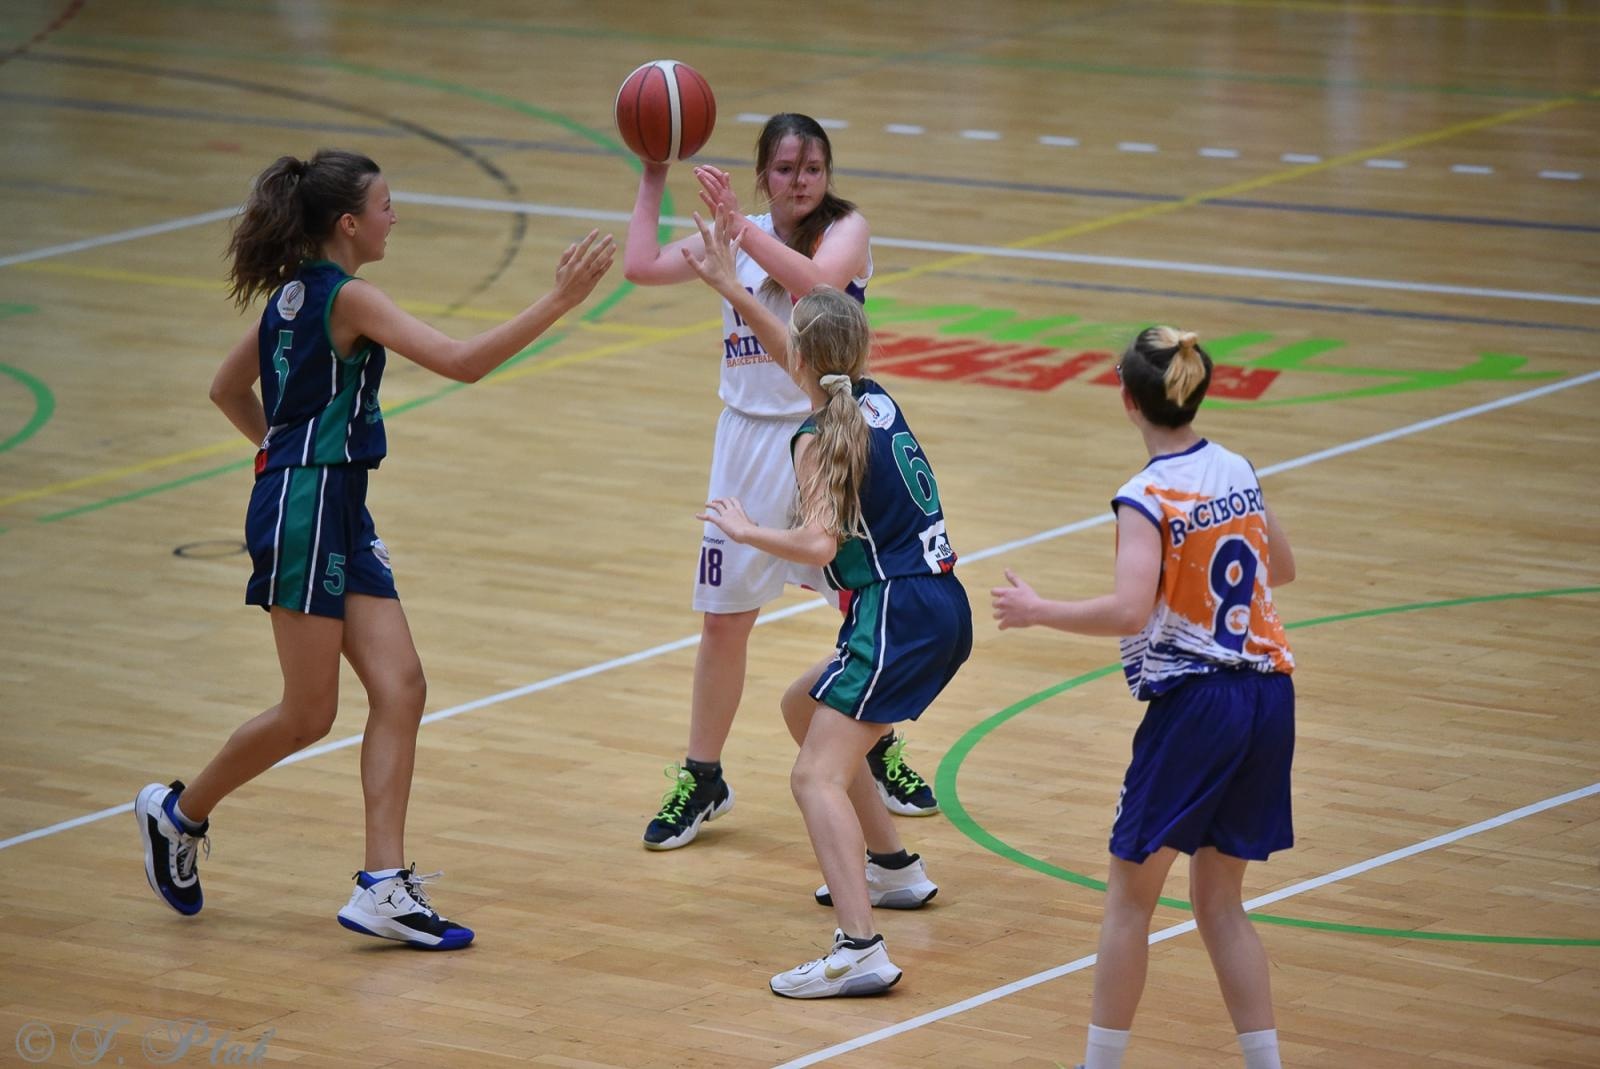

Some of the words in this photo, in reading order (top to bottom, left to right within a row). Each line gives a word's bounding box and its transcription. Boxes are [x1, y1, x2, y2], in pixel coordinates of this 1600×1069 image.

[272, 329, 294, 417] 5
[891, 431, 941, 516] 6
[323, 552, 347, 596] 5
[700, 546, 723, 587] 18
[1209, 536, 1259, 655] 8
